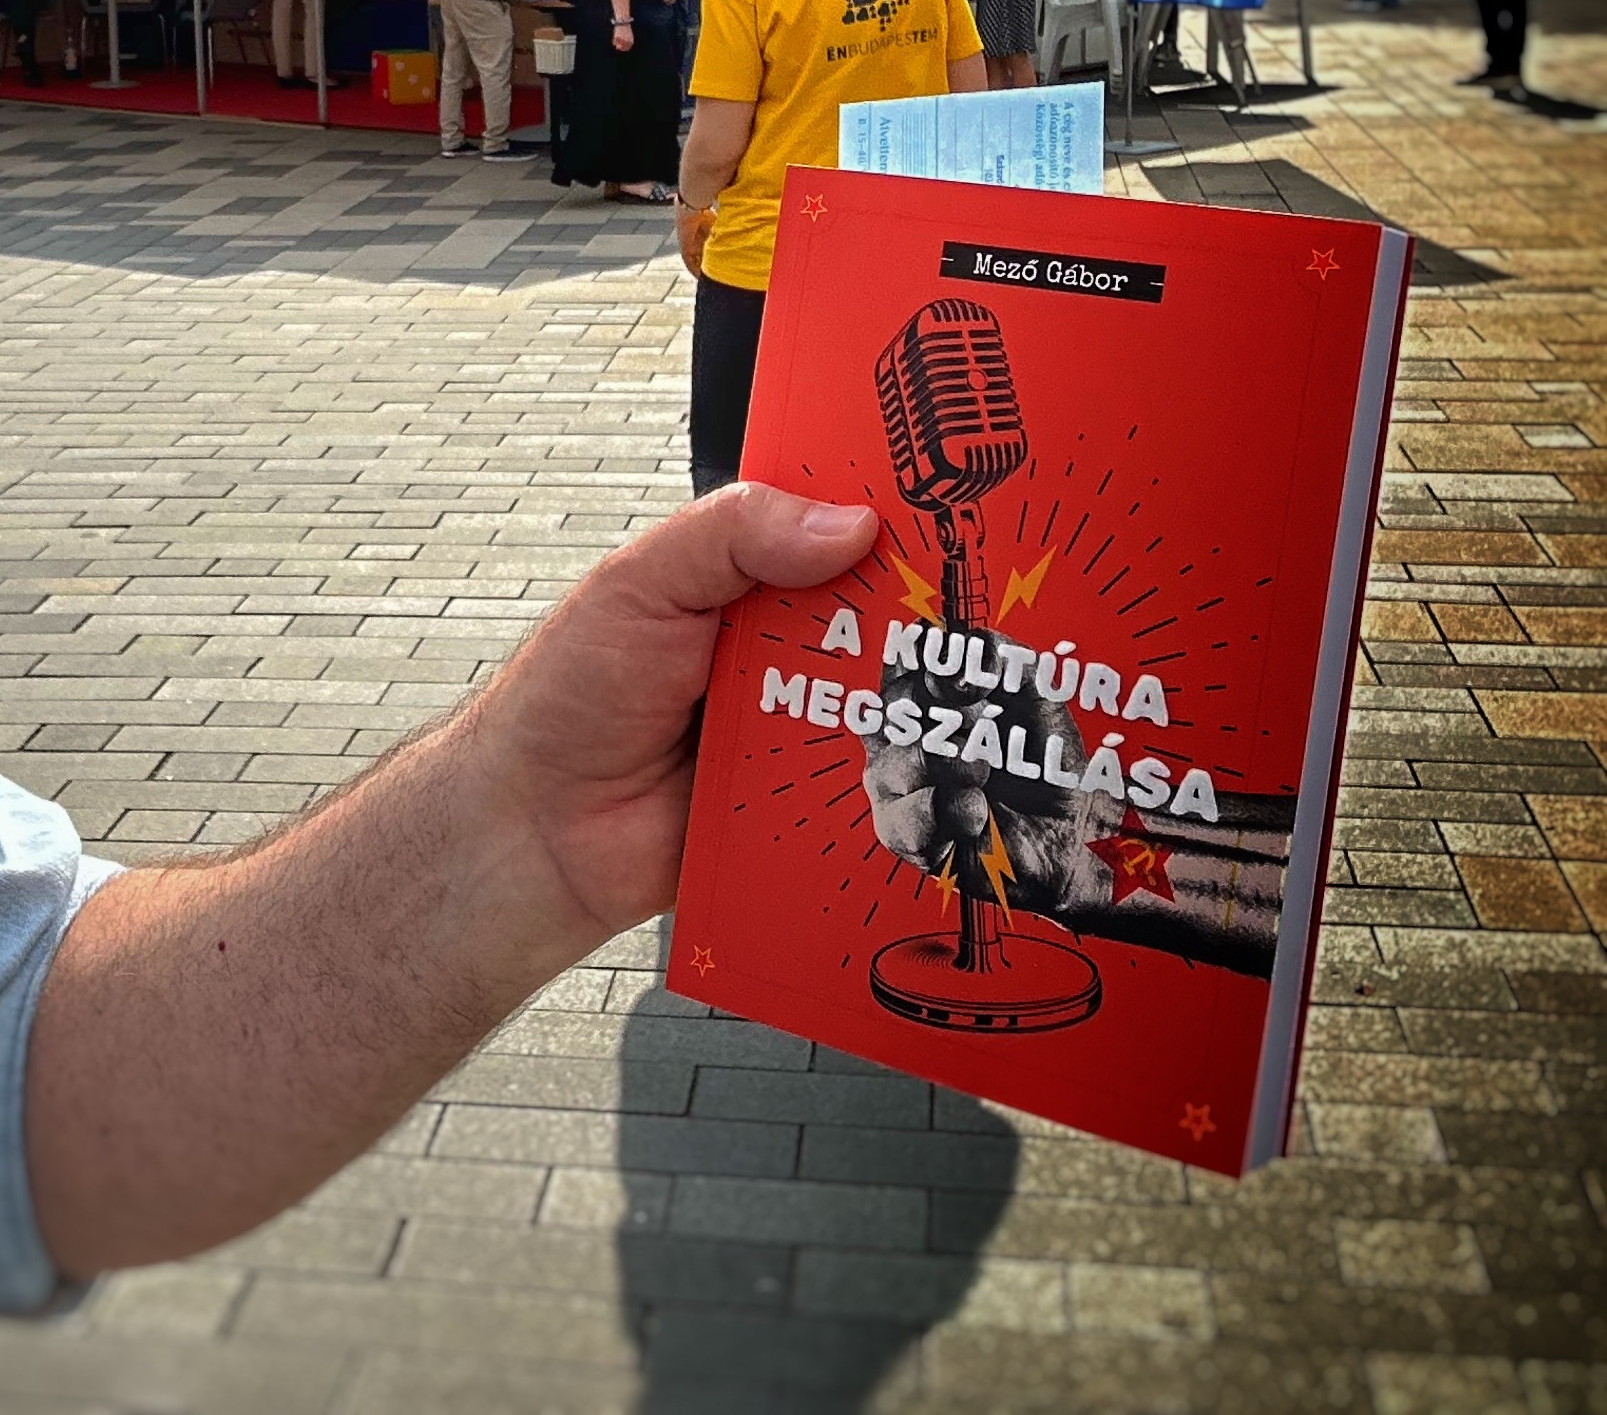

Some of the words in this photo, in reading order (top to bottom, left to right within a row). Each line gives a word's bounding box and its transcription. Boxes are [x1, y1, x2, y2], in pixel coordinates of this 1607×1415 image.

[973, 252, 1039, 282] Mező
[1045, 260, 1129, 292] Gábor
[821, 607, 862, 657] A
[882, 619, 1170, 728] KULTÚRA
[759, 666, 1220, 824] MEGSZÁLLÁSA
